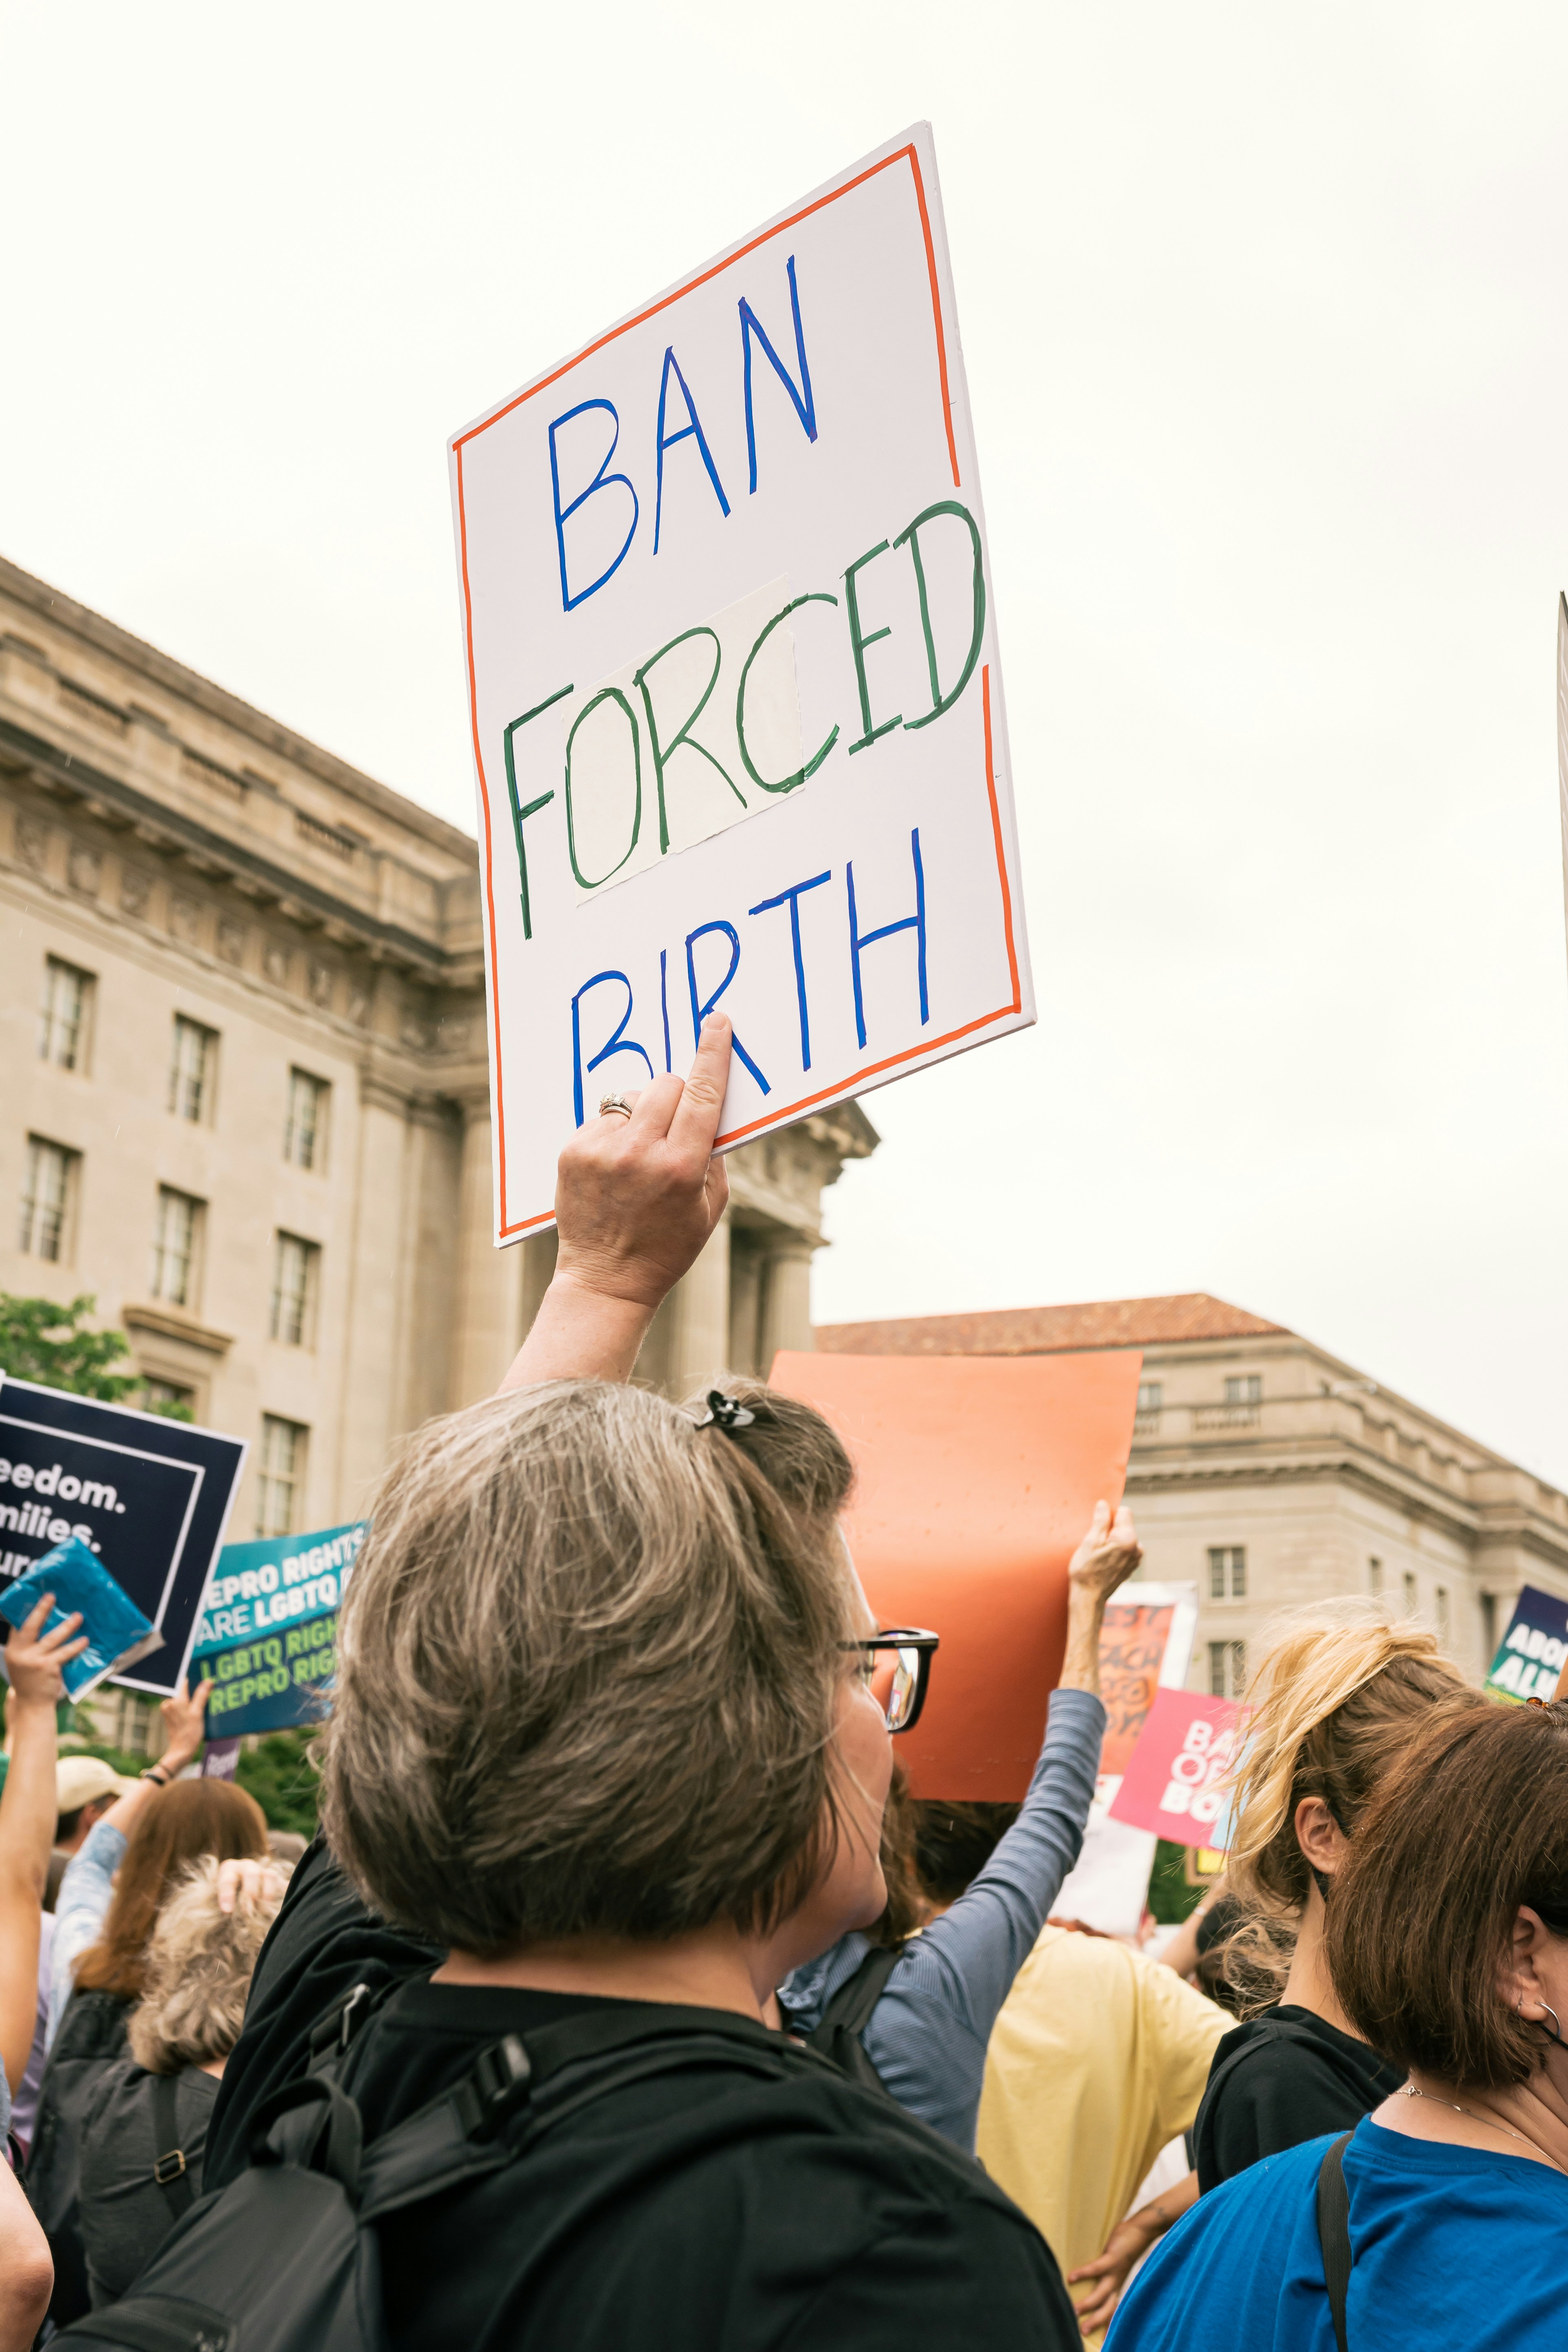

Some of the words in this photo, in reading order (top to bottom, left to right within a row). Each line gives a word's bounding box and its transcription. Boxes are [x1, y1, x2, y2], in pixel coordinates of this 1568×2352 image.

[548, 255, 817, 612] BAN
[503, 500, 986, 940] FORCED
[571, 827, 930, 1129] BIRTH
[194, 1604, 250, 1647] ARE
[254, 1574, 338, 1627] LGBTQ
[204, 1564, 279, 1612] EPRO
[200, 1637, 282, 1685] LGBTQ
[209, 1666, 290, 1716] REPRO
[294, 1648, 338, 1686] RIG
